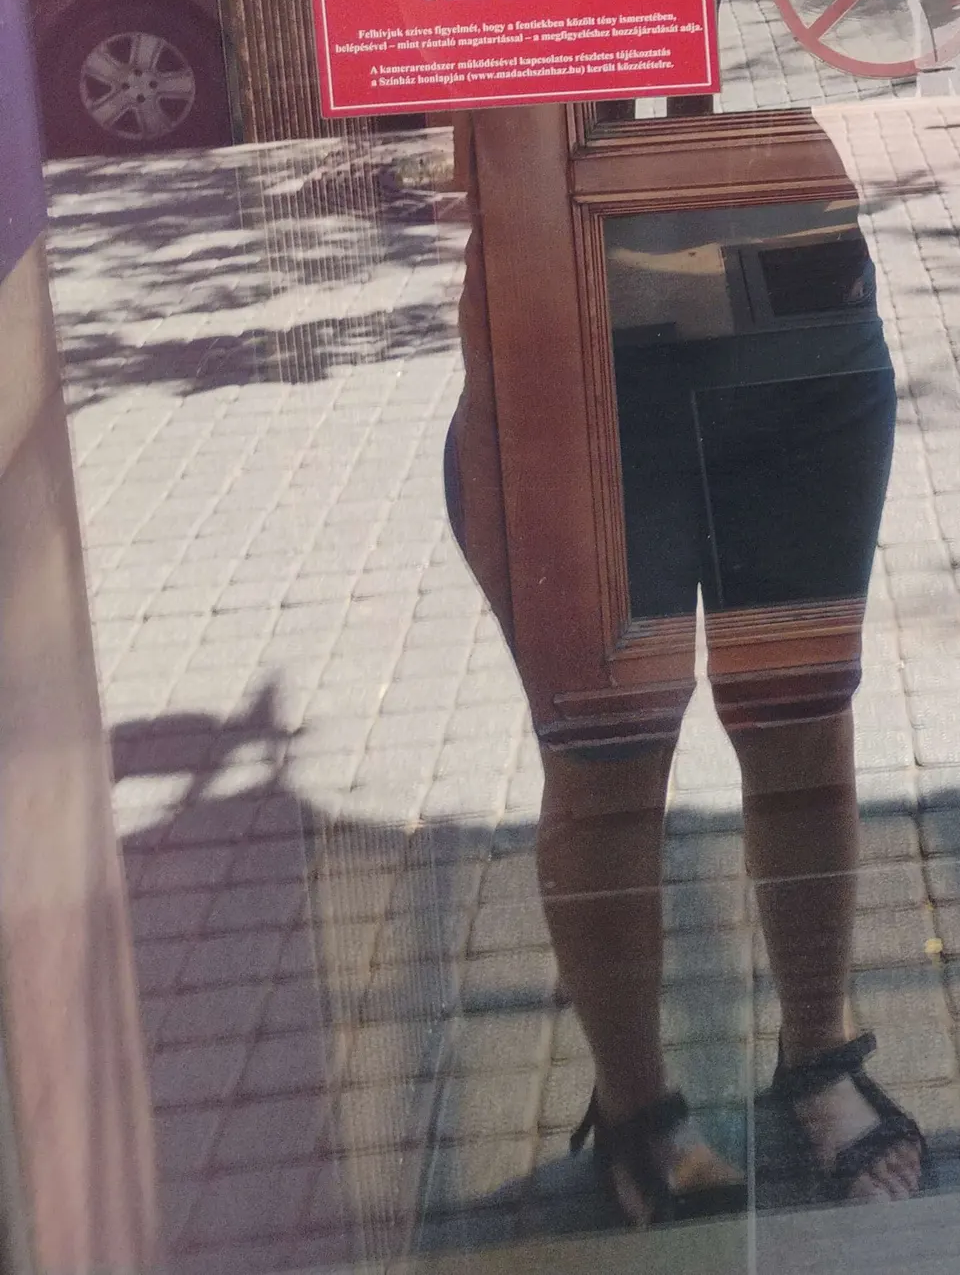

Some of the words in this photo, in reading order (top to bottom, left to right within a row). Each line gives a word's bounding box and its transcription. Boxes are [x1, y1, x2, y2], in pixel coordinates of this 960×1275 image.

[335, 41, 388, 54] belépésével
[397, 40, 419, 50] mint
[421, 37, 456, 49] ráutaló
[458, 32, 523, 47] magatartással
[541, 29, 610, 43] megfigyeléshez
[612, 23, 679, 37] hozzájárulását
[680, 22, 703, 34] adja.
[358, 26, 403, 39] Felhívjuk
[405, 26, 433, 37] szíves
[435, 24, 480, 36] figyelmét,
[483, 22, 505, 33] hogy
[516, 18, 564, 30] fentiekben
[566, 16, 595, 27] közölt
[597, 15, 617, 26] tény
[619, 12, 676, 25] ismeretében,
[370, 66, 378, 75] A
[380, 61, 455, 74] kamerarendszer
[519, 53, 573, 67] kapcsolatos
[575, 50, 614, 62] részletes
[616, 47, 671, 61] tájékoztatás
[379, 74, 416, 86] Színház
[418, 71, 465, 85] honlapján
[587, 61, 616, 73] került
